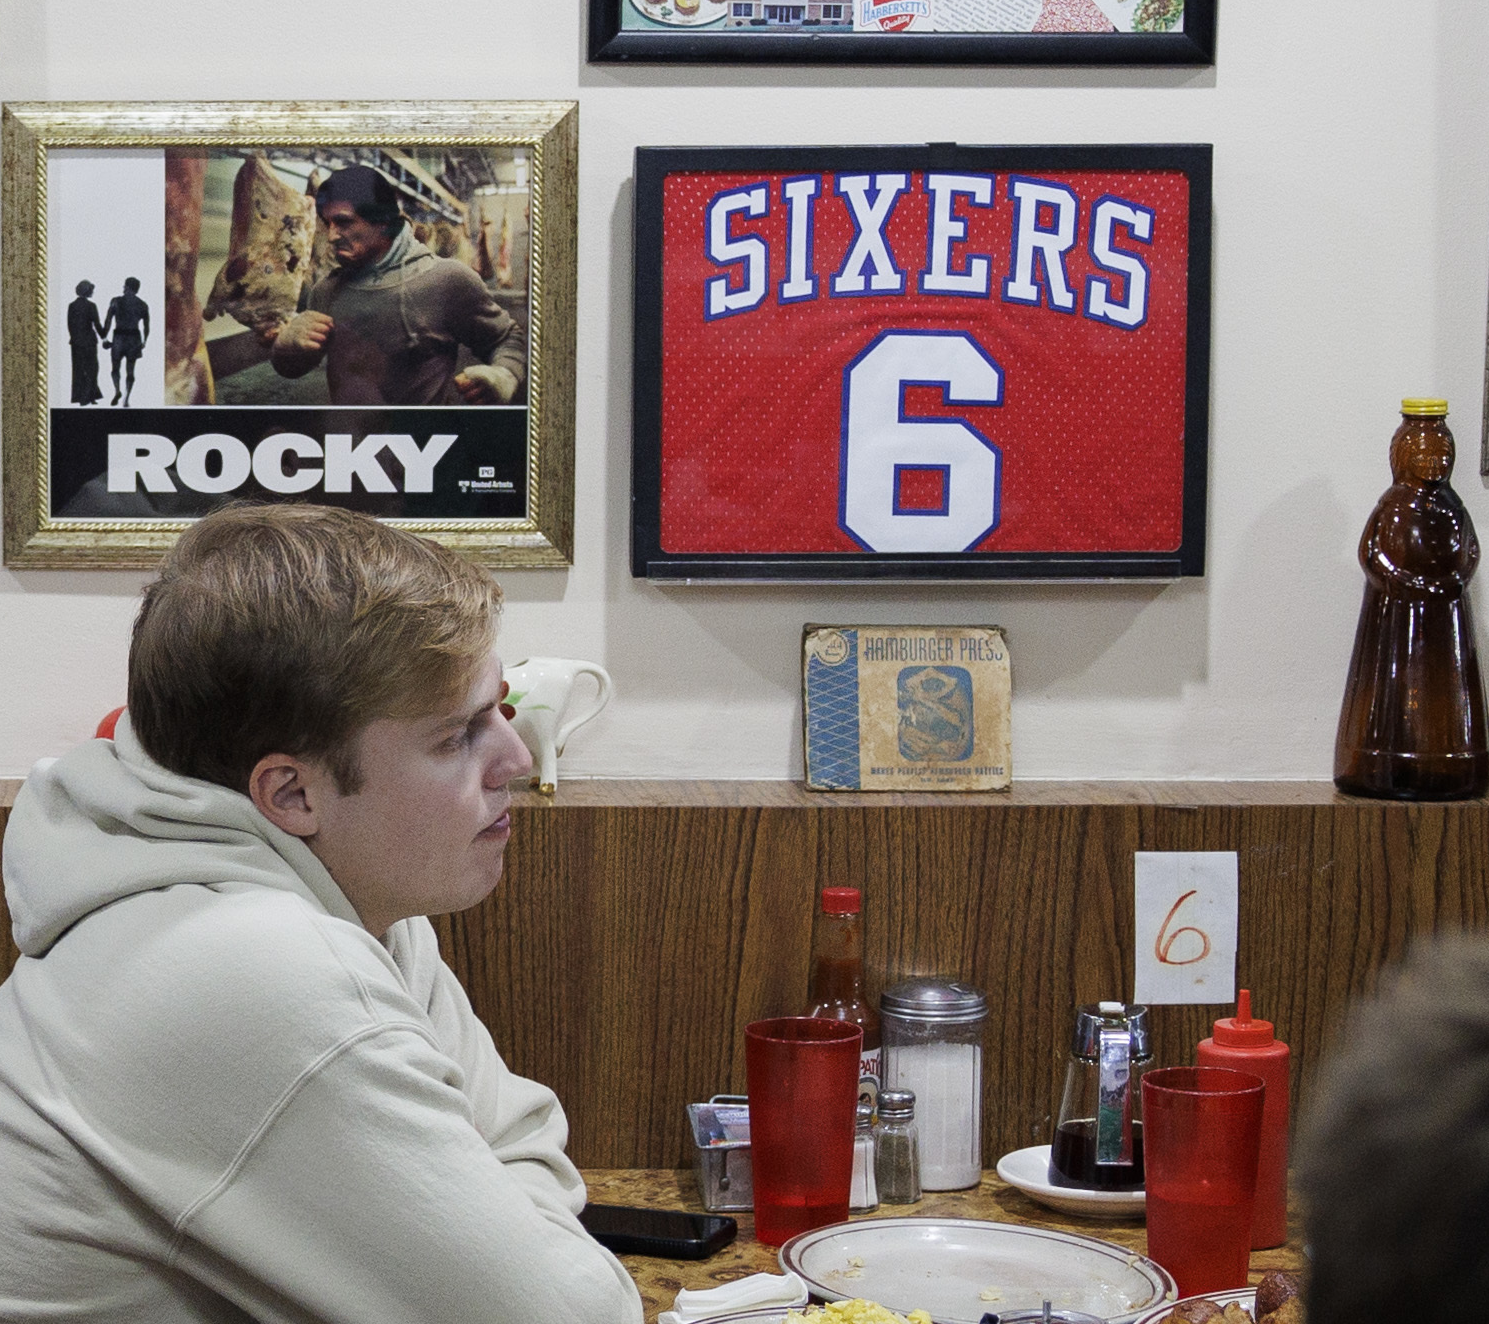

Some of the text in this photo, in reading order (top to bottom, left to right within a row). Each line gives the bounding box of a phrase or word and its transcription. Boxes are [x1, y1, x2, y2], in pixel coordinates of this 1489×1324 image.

[862, 0, 929, 24] HABBERSETT'S
[704, 171, 1154, 331] SIXERS
[107, 433, 459, 494] ROCKY
[838, 328, 1004, 552] 6
[864, 637, 954, 661] HAMBURGER
[1154, 889, 1212, 966] 6
